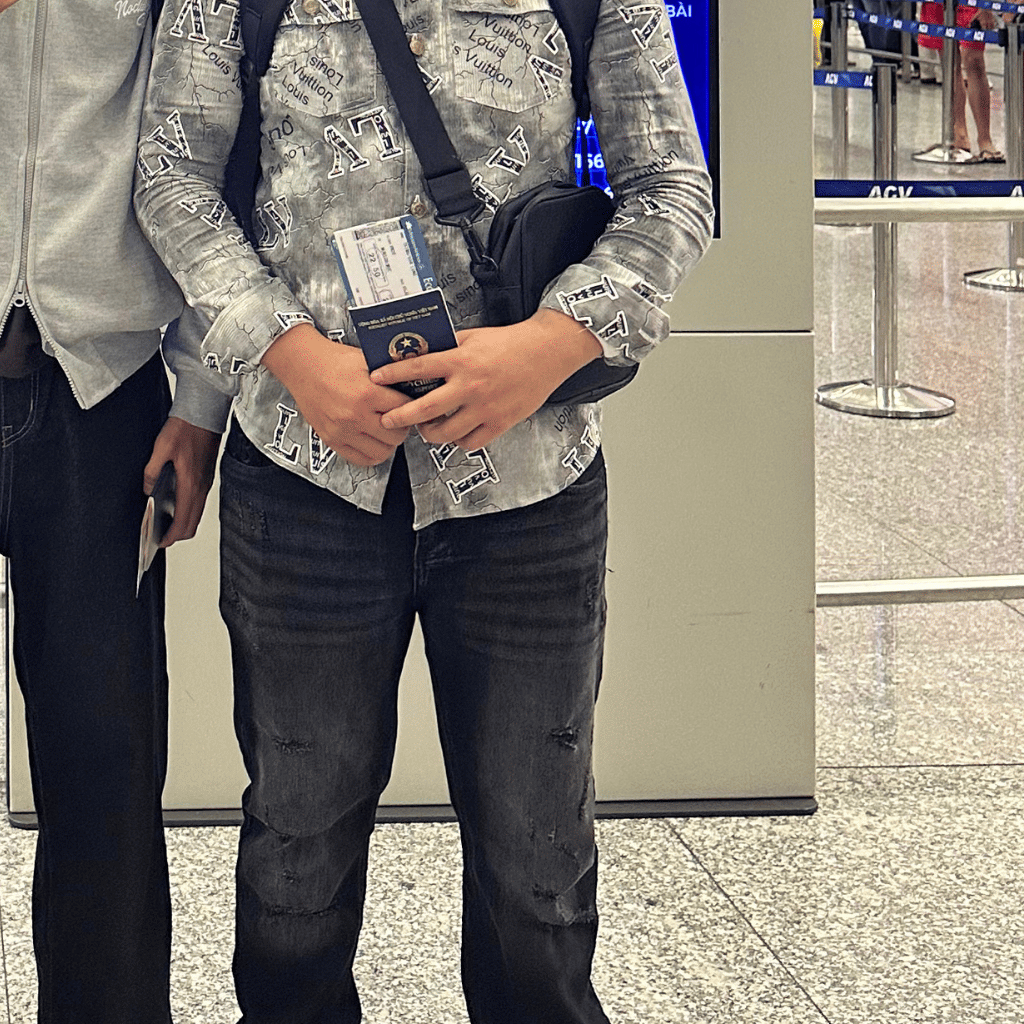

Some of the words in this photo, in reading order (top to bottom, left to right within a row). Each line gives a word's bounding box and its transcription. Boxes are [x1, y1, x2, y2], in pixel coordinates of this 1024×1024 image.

[468, 29, 506, 58] Louis
[202, 44, 232, 76] Louis
[282, 75, 309, 105] Louis
[824, 73, 838, 85] ACV
